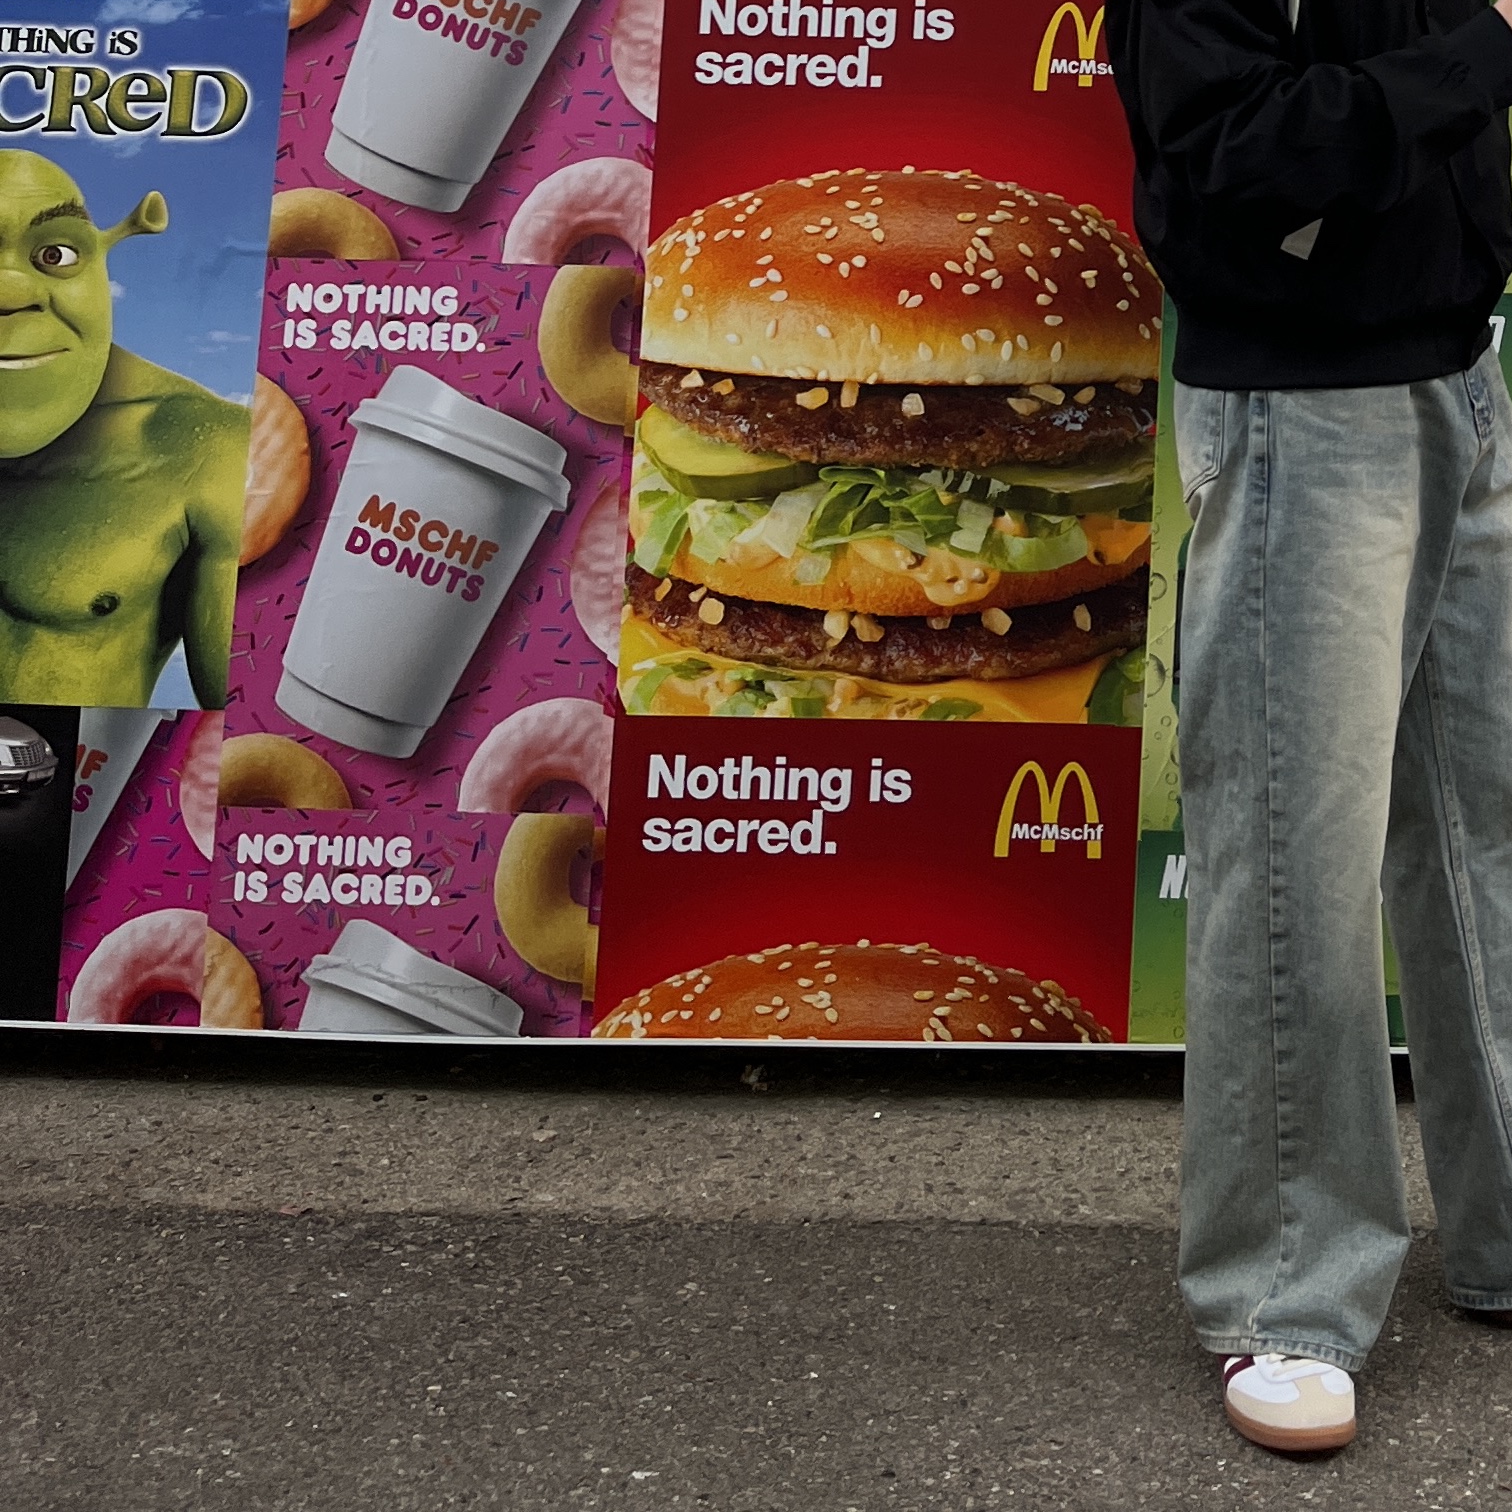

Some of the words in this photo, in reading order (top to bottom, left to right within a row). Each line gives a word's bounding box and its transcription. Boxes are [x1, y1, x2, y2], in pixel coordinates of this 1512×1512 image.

[912, 0, 954, 41] is
[694, 45, 883, 88] sacred.
[286, 282, 458, 316] NOTHING
[283, 318, 317, 349] IS
[330, 320, 486, 352] SACRED.
[358, 494, 499, 570] MSCHF
[345, 526, 485, 602] DONUTS
[647, 754, 851, 812] Nothing
[868, 758, 912, 803] is
[237, 833, 413, 868] NOTHING
[642, 808, 837, 854] sacred.
[1011, 822, 1104, 842] McMschf
[233, 871, 268, 903] IS
[282, 872, 441, 906] SACRED.
